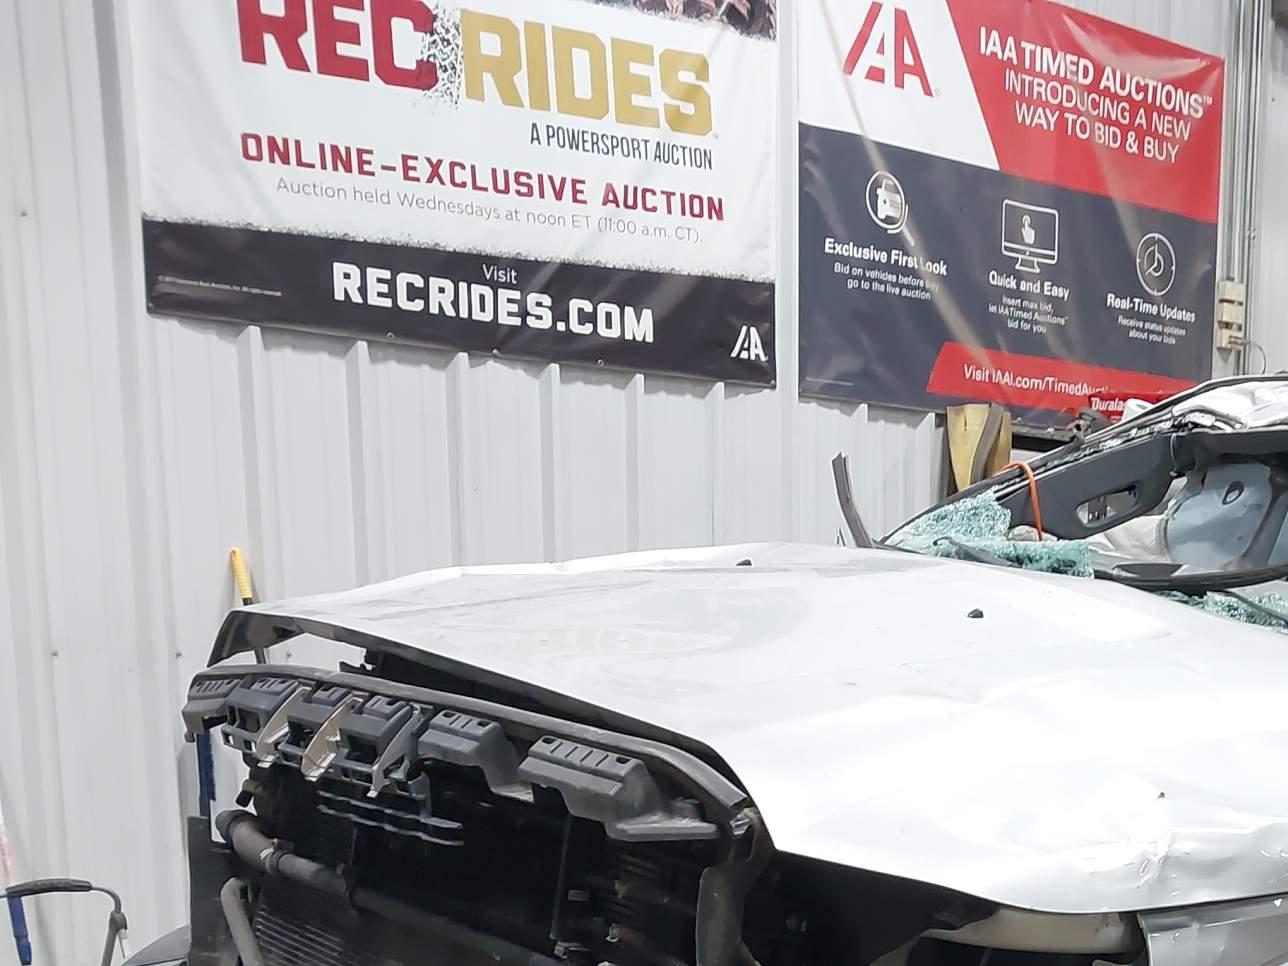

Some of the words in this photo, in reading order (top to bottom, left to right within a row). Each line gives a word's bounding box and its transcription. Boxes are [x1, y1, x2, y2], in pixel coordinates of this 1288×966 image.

[237, 0, 439, 91] REC
[460, 8, 713, 137] RIDES
[979, 26, 1017, 65] IAA
[1020, 40, 1094, 86] TIMED
[1005, 68, 1130, 125] INTRODUCING
[1135, 107, 1147, 130] A
[1152, 111, 1191, 141] NEW
[530, 122, 541, 146] A
[547, 125, 650, 161] POWERSPORT
[654, 141, 713, 171] AUCTION
[1015, 100, 1060, 132] WAY
[1064, 112, 1091, 139] TO
[1094, 122, 1121, 149] BID
[1125, 131, 1139, 154] &
[1143, 137, 1179, 163] BUY
[241, 132, 588, 205] ONLINE-EXCLUSIVE
[601, 182, 724, 221] AUCTION
[276, 177, 347, 200] Auction
[353, 186, 391, 205] held
[397, 191, 500, 221] Wednesdays
[505, 208, 521, 222] at
[526, 209, 566, 228] noon
[571, 215, 592, 229] ET
[598, 216, 637, 235] (11:00
[641, 223, 670, 240] a.m.
[675, 225, 703, 244] CT).
[824, 237, 888, 263] Exclusive
[890, 249, 918, 269] First
[482, 263, 518, 285] Visit
[834, 262, 850, 274] Bid
[852, 266, 863, 277] on
[865, 269, 897, 283] vehicles
[898, 273, 924, 288] before
[847, 278, 859, 289] go
[861, 279, 870, 290] to
[872, 281, 885, 293] the
[886, 283, 900, 295] live
[901, 287, 931, 301] auction
[989, 270, 1017, 290] Quick
[1020, 279, 1041, 293] and
[1043, 281, 1070, 302] Easy
[332, 261, 654, 343] RECRIDES.COM
[1106, 292, 1158, 316] Real-Time
[1160, 303, 1196, 323] Updates
[1020, 319, 1031, 331] for
[1032, 324, 1047, 334] you
[963, 363, 990, 382] Visit
